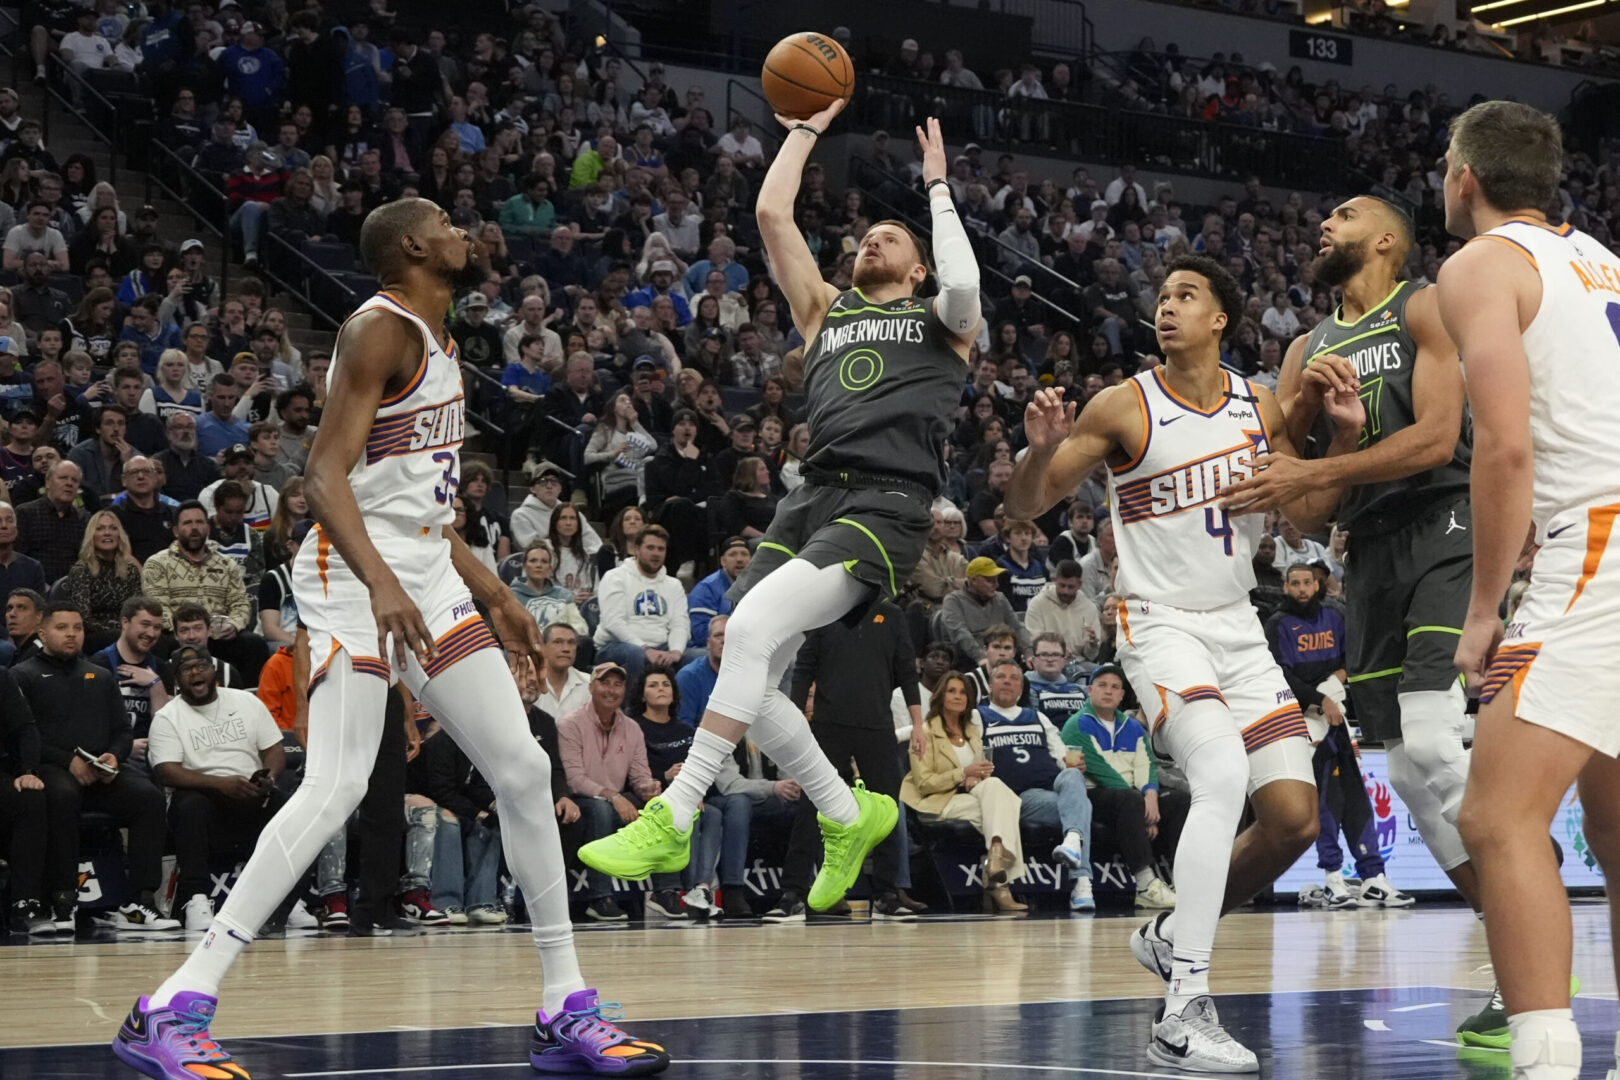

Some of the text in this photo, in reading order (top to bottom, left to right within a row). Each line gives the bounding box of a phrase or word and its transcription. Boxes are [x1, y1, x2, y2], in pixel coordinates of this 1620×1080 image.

[1306, 37, 1337, 59] 133
[820, 318, 925, 357] TIMBERWOLVES
[839, 348, 884, 391] 0
[1344, 341, 1401, 379] WOLVES
[1228, 410, 1253, 421] PayPal
[1150, 448, 1255, 516] SUNS
[1204, 505, 1235, 557] 4
[1012, 585, 1042, 597] MINNESO
[1297, 629, 1336, 653] SUNS
[189, 718, 247, 751] NIKE
[988, 733, 1042, 748] MINNESOTA
[1012, 746, 1031, 763] 5
